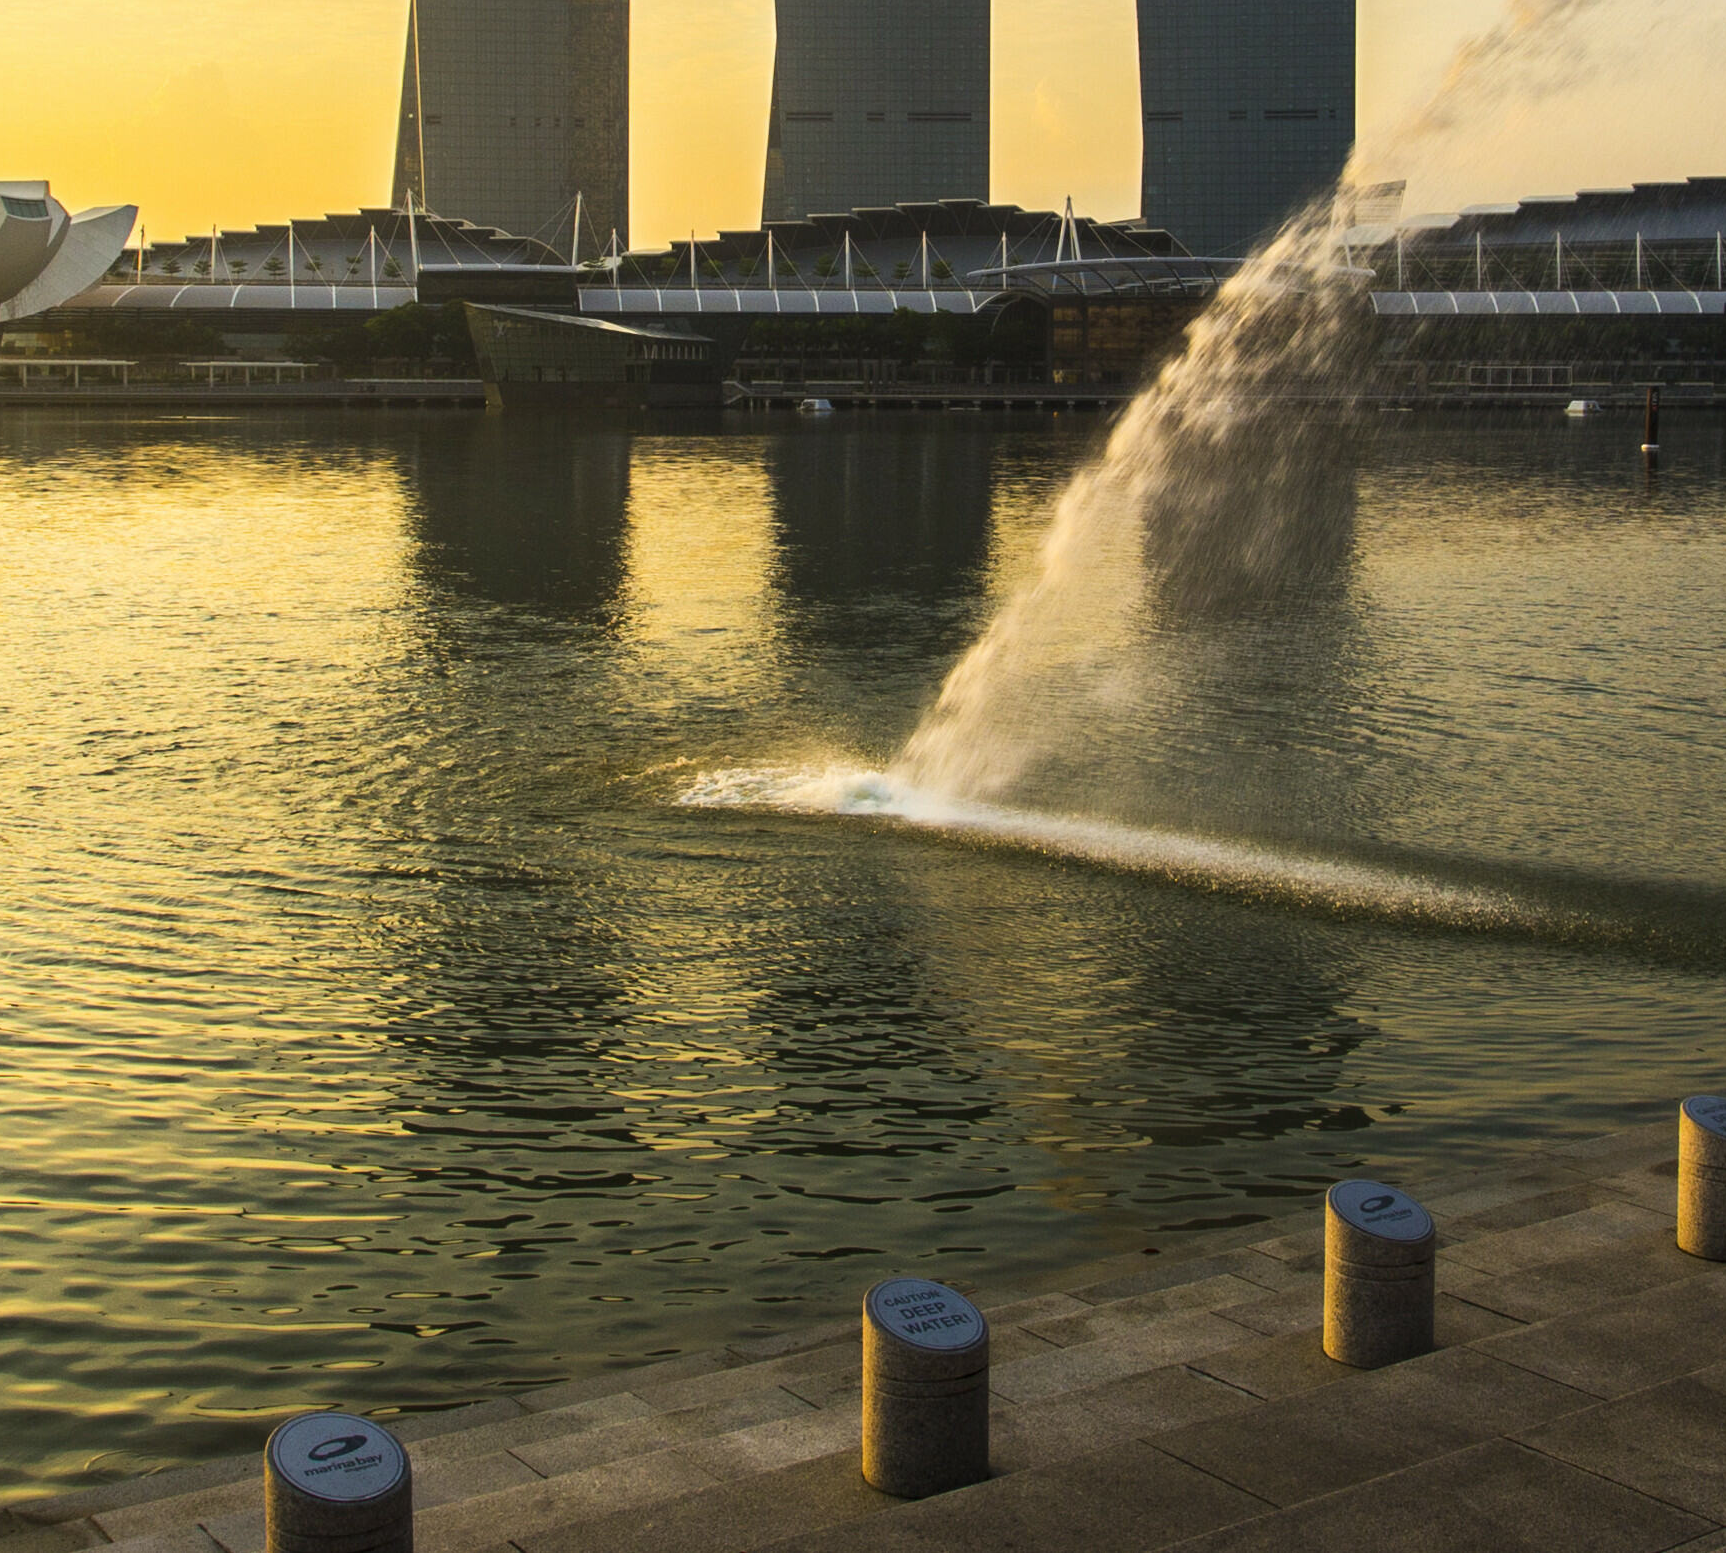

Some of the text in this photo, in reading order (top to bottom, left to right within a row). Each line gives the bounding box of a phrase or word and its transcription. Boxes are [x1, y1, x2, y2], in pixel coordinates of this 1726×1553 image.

[884, 1289, 942, 1307] CAUTION
[899, 1302, 946, 1319] DEEP
[902, 1313, 973, 1335] WATER!
[304, 1454, 382, 1476] marina bay
